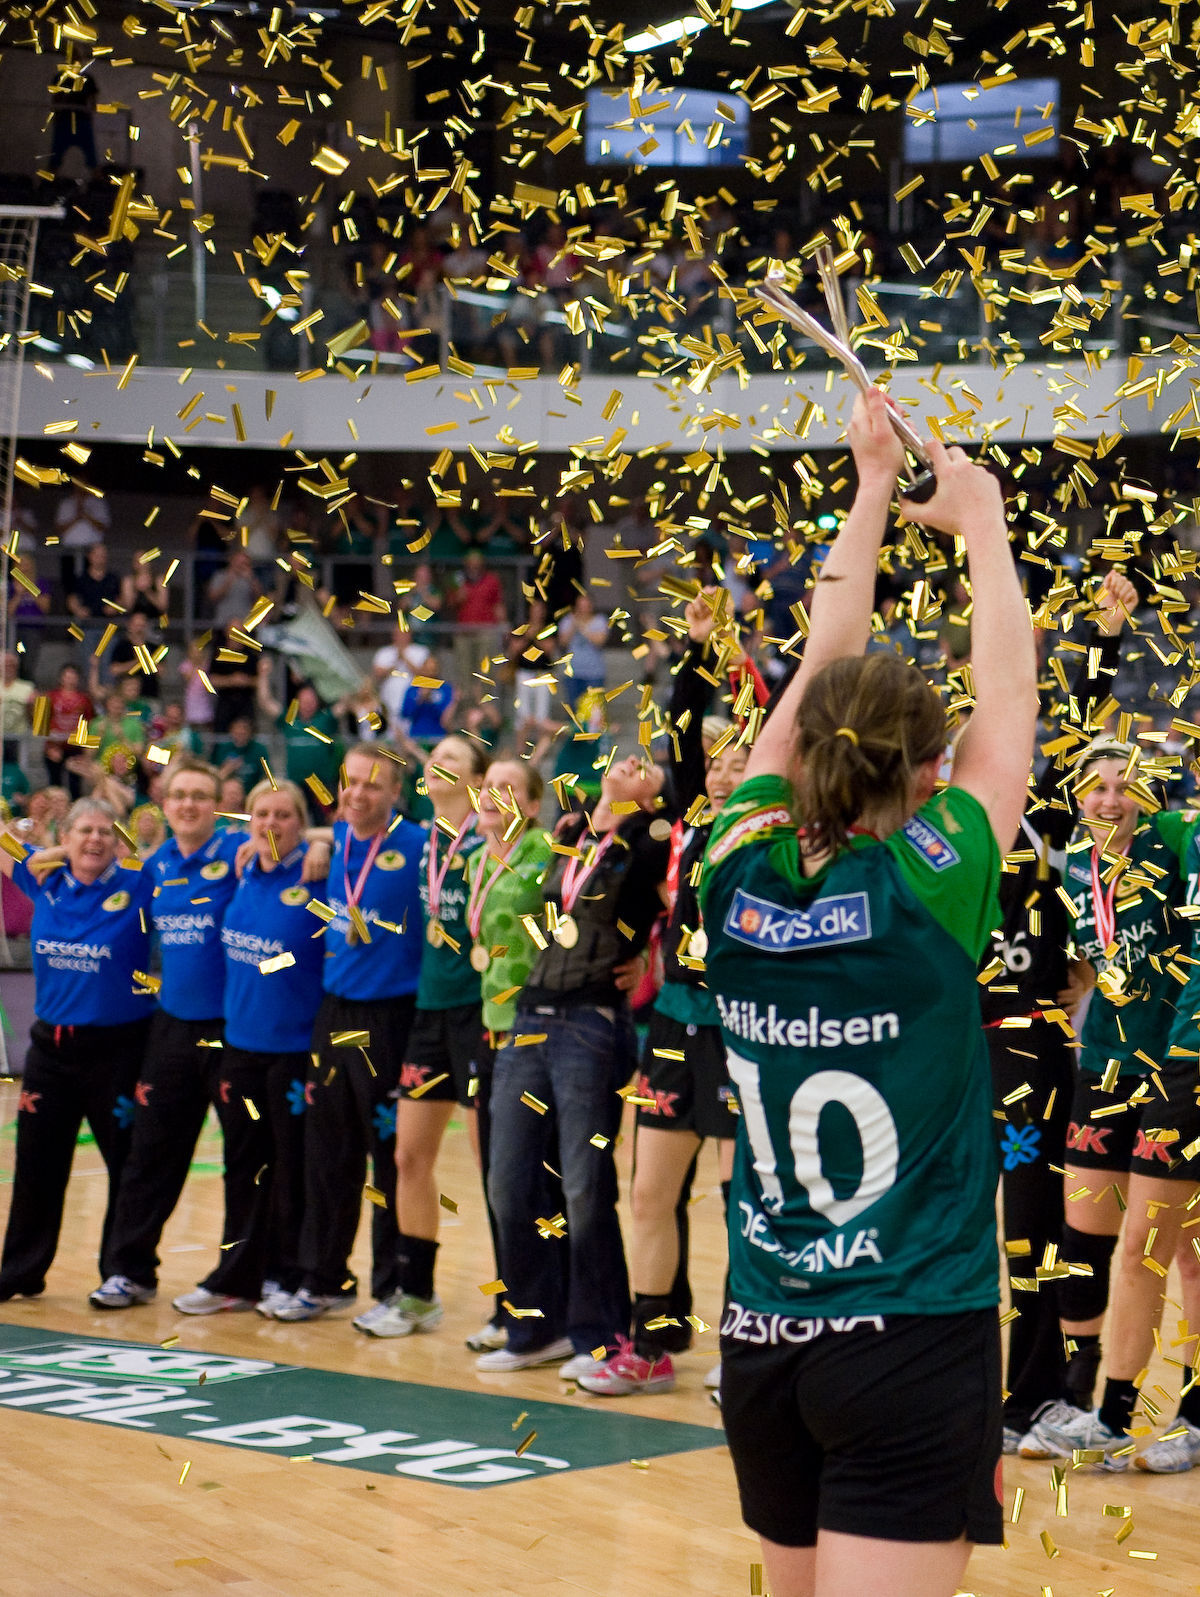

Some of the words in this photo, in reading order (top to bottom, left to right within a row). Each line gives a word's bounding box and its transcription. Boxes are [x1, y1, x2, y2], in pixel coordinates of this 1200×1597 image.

[35, 939, 112, 960] DESIGNA
[715, 994, 900, 1047] Mikkelsen
[725, 1046, 899, 1227] 10
[0, 1369, 569, 1484] TÅL-BYG
